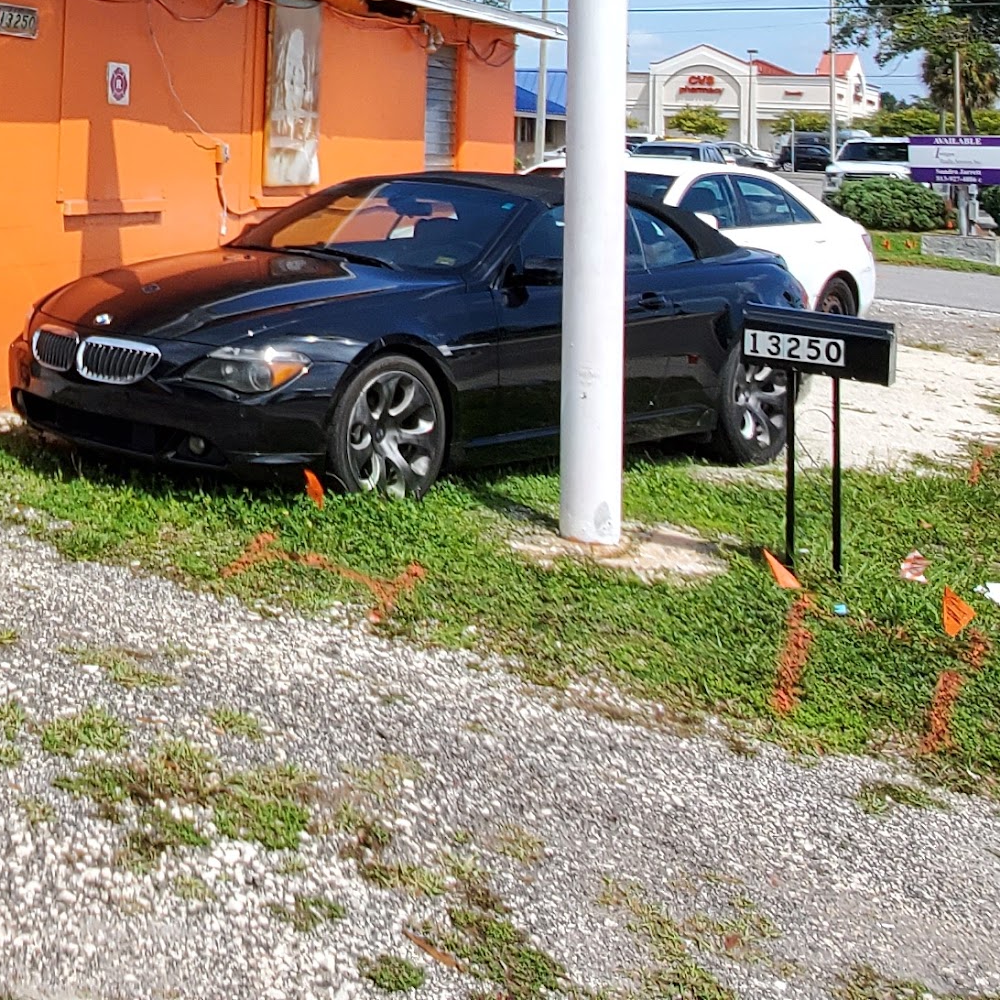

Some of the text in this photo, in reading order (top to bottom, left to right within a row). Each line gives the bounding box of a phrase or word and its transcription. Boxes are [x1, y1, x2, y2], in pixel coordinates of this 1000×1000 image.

[0, 11, 36, 29] 13250
[688, 75, 715, 86] CVS
[678, 85, 724, 96] pharmacy
[933, 137, 982, 145] AVAILABLE
[750, 333, 842, 363] 13250
